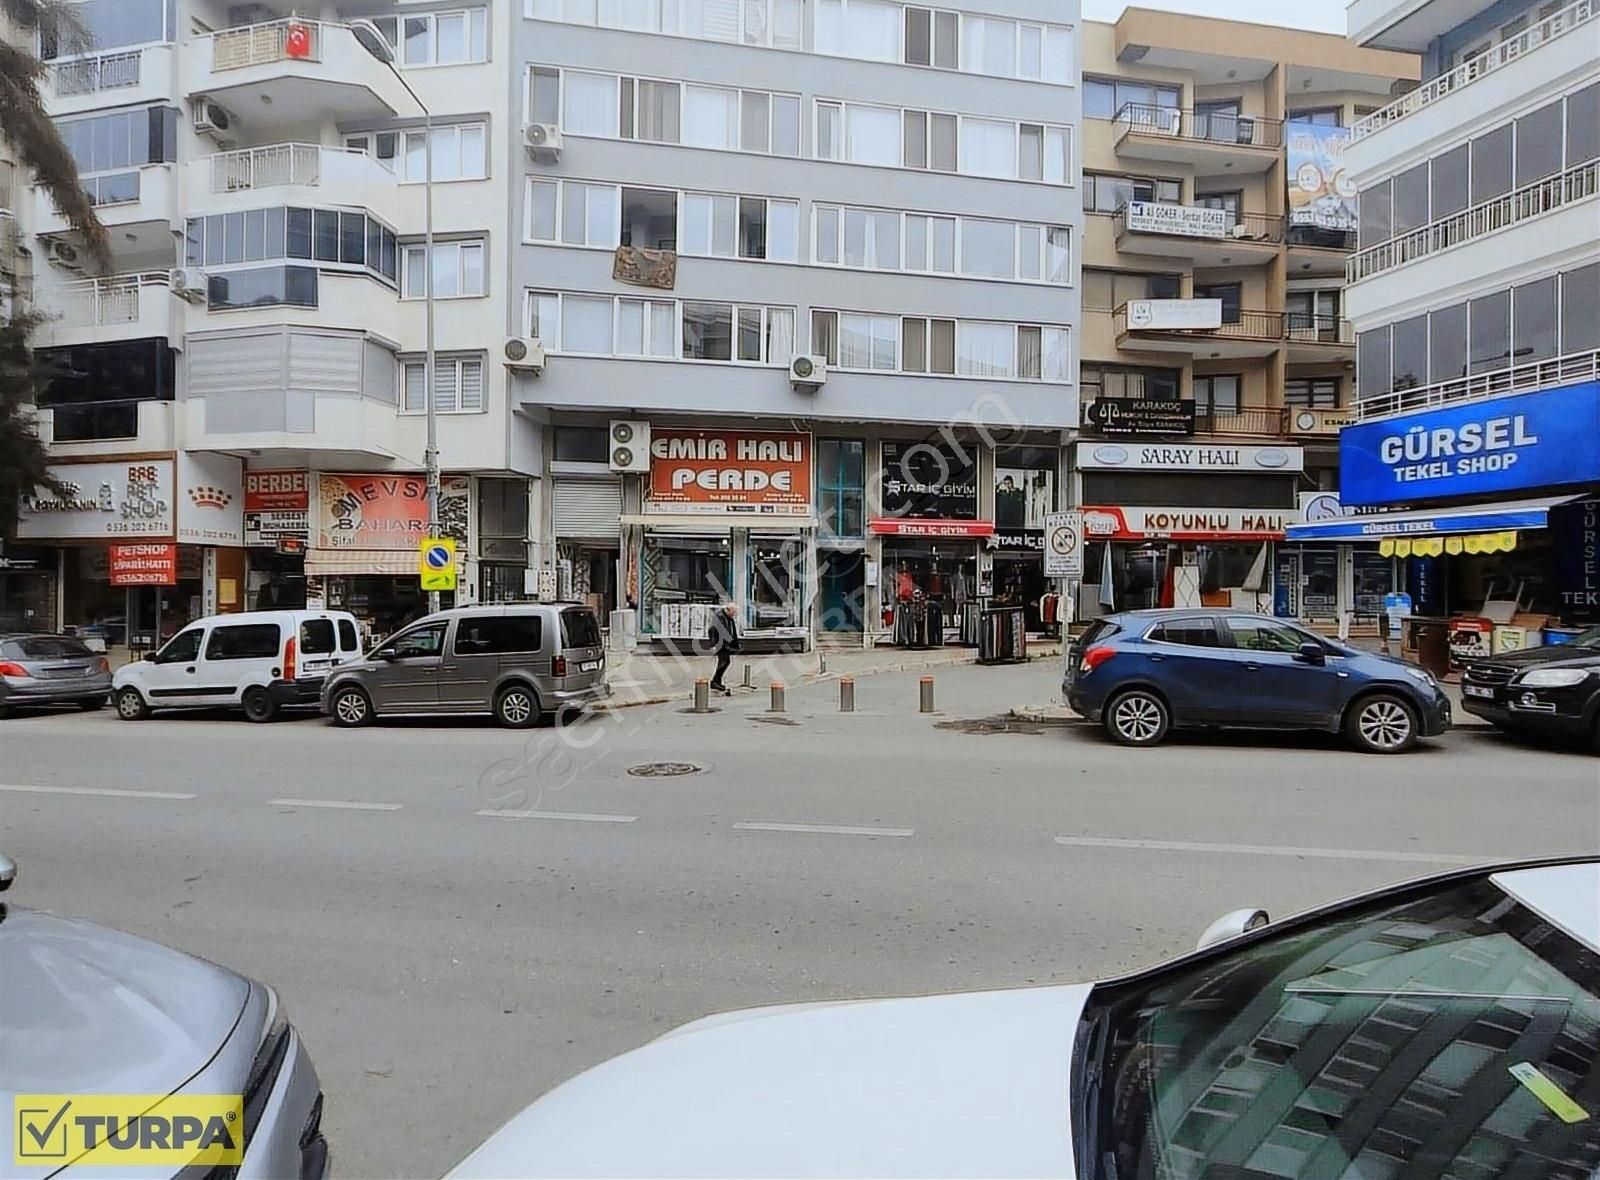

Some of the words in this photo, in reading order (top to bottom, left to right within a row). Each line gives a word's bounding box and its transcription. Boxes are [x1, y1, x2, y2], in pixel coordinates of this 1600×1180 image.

[651, 432, 727, 460] EMİR
[737, 440, 802, 462] HALI
[1380, 414, 1538, 464] GÜRSEL
[1141, 449, 1192, 465] SARAY
[1199, 450, 1239, 466] HALI
[1393, 462, 1453, 482] TEKEL
[1457, 453, 1518, 474] SHOP
[672, 469, 791, 491] PERDE
[944, 481, 975, 494] GİYİM
[120, 500, 168, 519] SHOP
[1145, 513, 1229, 529] KOYUNLU
[1242, 515, 1282, 530] HALI
[117, 544, 169, 556] PETSHOP
